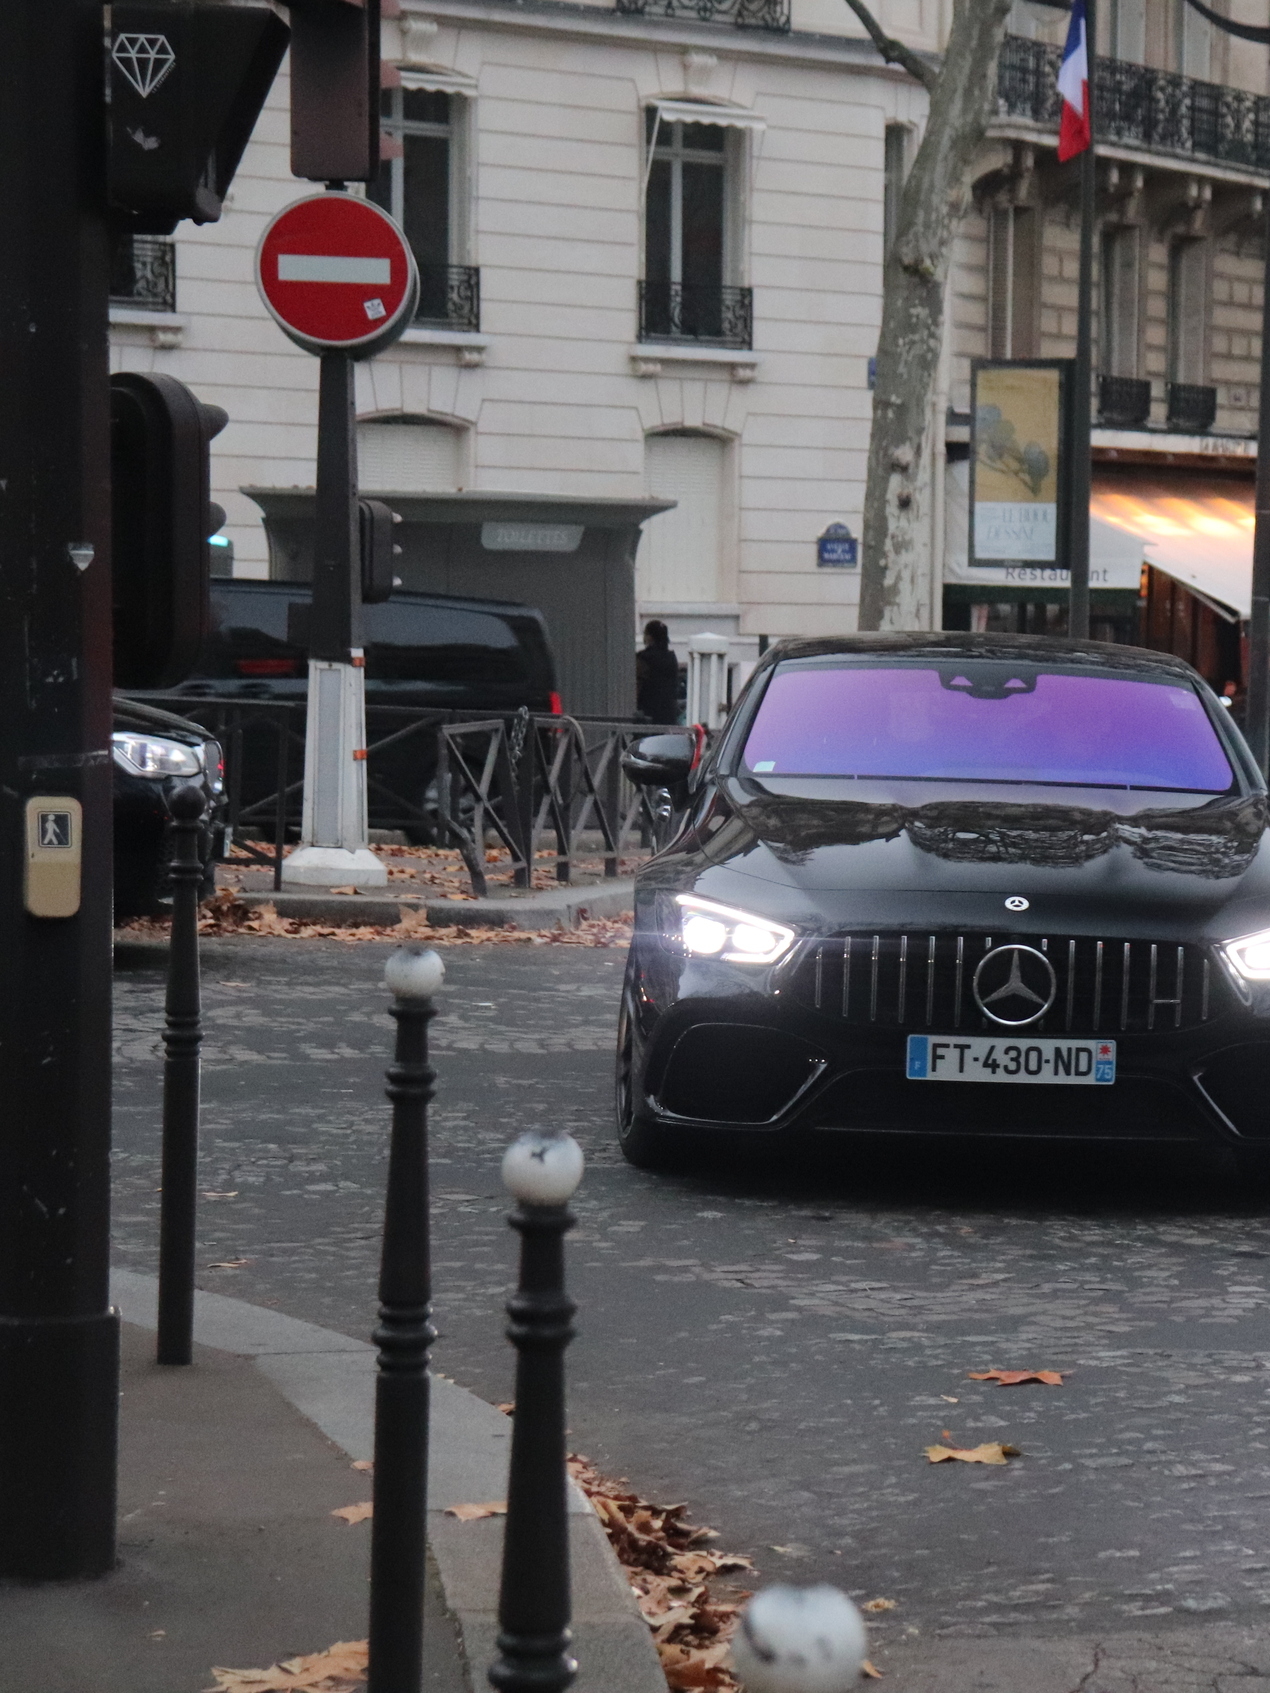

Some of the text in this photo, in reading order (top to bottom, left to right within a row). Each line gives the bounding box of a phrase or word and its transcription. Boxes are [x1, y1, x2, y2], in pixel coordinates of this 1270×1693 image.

[1004, 567, 1110, 583] Restaunt
[930, 1042, 1093, 1077] FT-430-ND
[1096, 1064, 1113, 1080] 75
